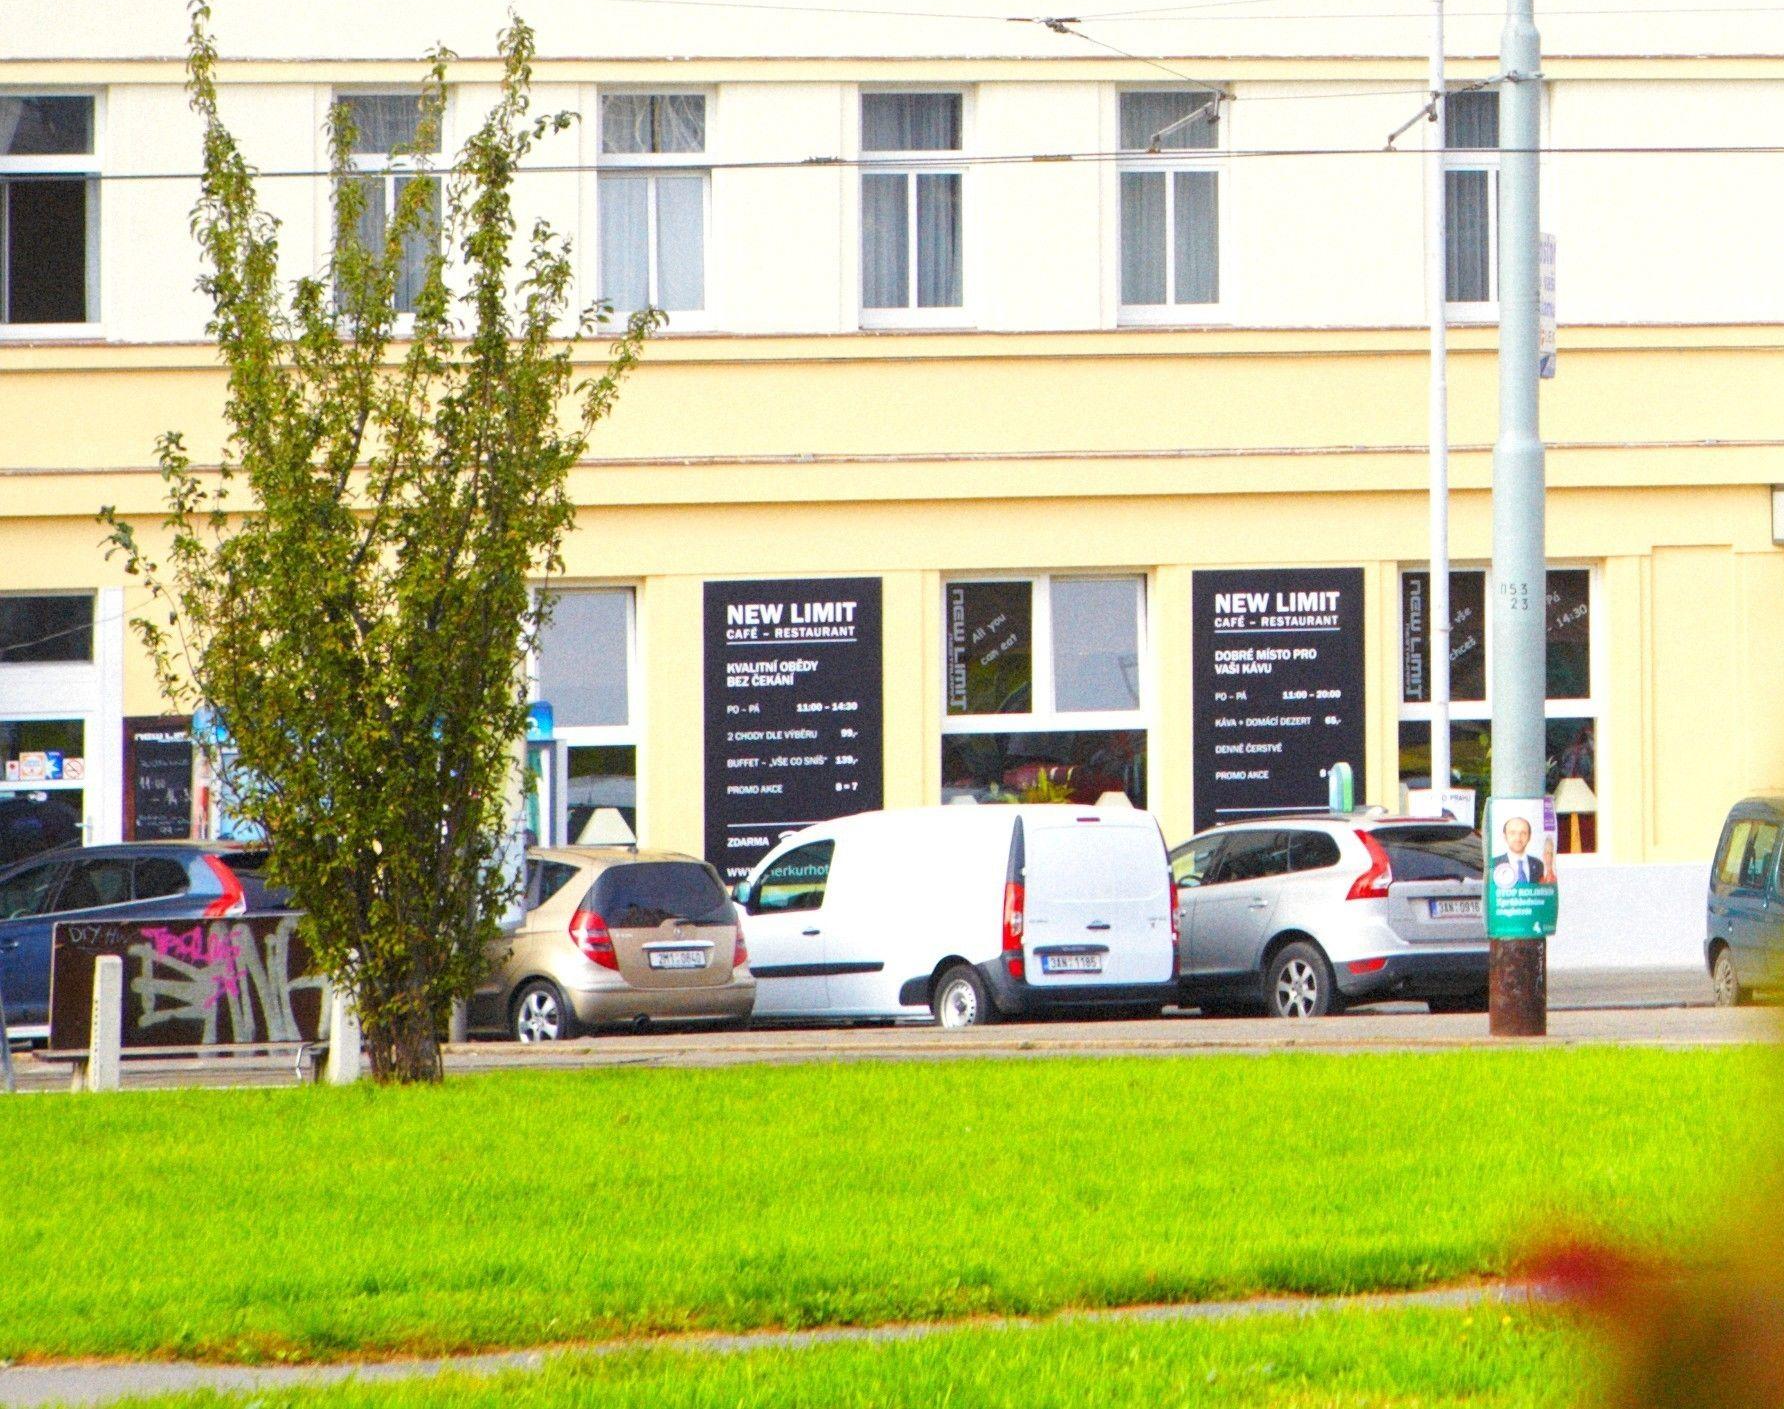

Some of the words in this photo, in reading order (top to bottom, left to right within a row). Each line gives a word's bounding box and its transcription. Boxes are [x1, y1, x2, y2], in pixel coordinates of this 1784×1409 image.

[1215, 593, 1269, 613] NEW
[1276, 591, 1340, 612] LIMIT
[1510, 598, 1529, 611] 23
[727, 603, 783, 625] NEW
[790, 601, 857, 623] LIMIT
[1556, 603, 1588, 629] 14:30
[1214, 615, 1245, 628] CAFÉ
[1261, 615, 1339, 627] RESTAURANT
[726, 627, 758, 640] CAFÉ
[775, 626, 855, 639] RESTAURANT
[1215, 648, 1254, 661] DOBRÉ
[1256, 647, 1291, 661] MÍSTO
[1293, 648, 1317, 660] PRO
[727, 659, 778, 674] KVALITNÍ
[780, 658, 818, 672] OBĚDY
[1215, 662, 1240, 674] VAŠI
[1242, 661, 1272, 674] KÁVU
[727, 675, 749, 687] BEZ
[751, 672, 794, 687] ČEKÁNÍ
[1215, 692, 1227, 701] PO
[727, 704, 740, 714] PO
[1215, 716, 1237, 727] KÁVA
[727, 732, 734, 741] 2
[851, 781, 859, 791] 7
[727, 836, 770, 848] ZDARMA
